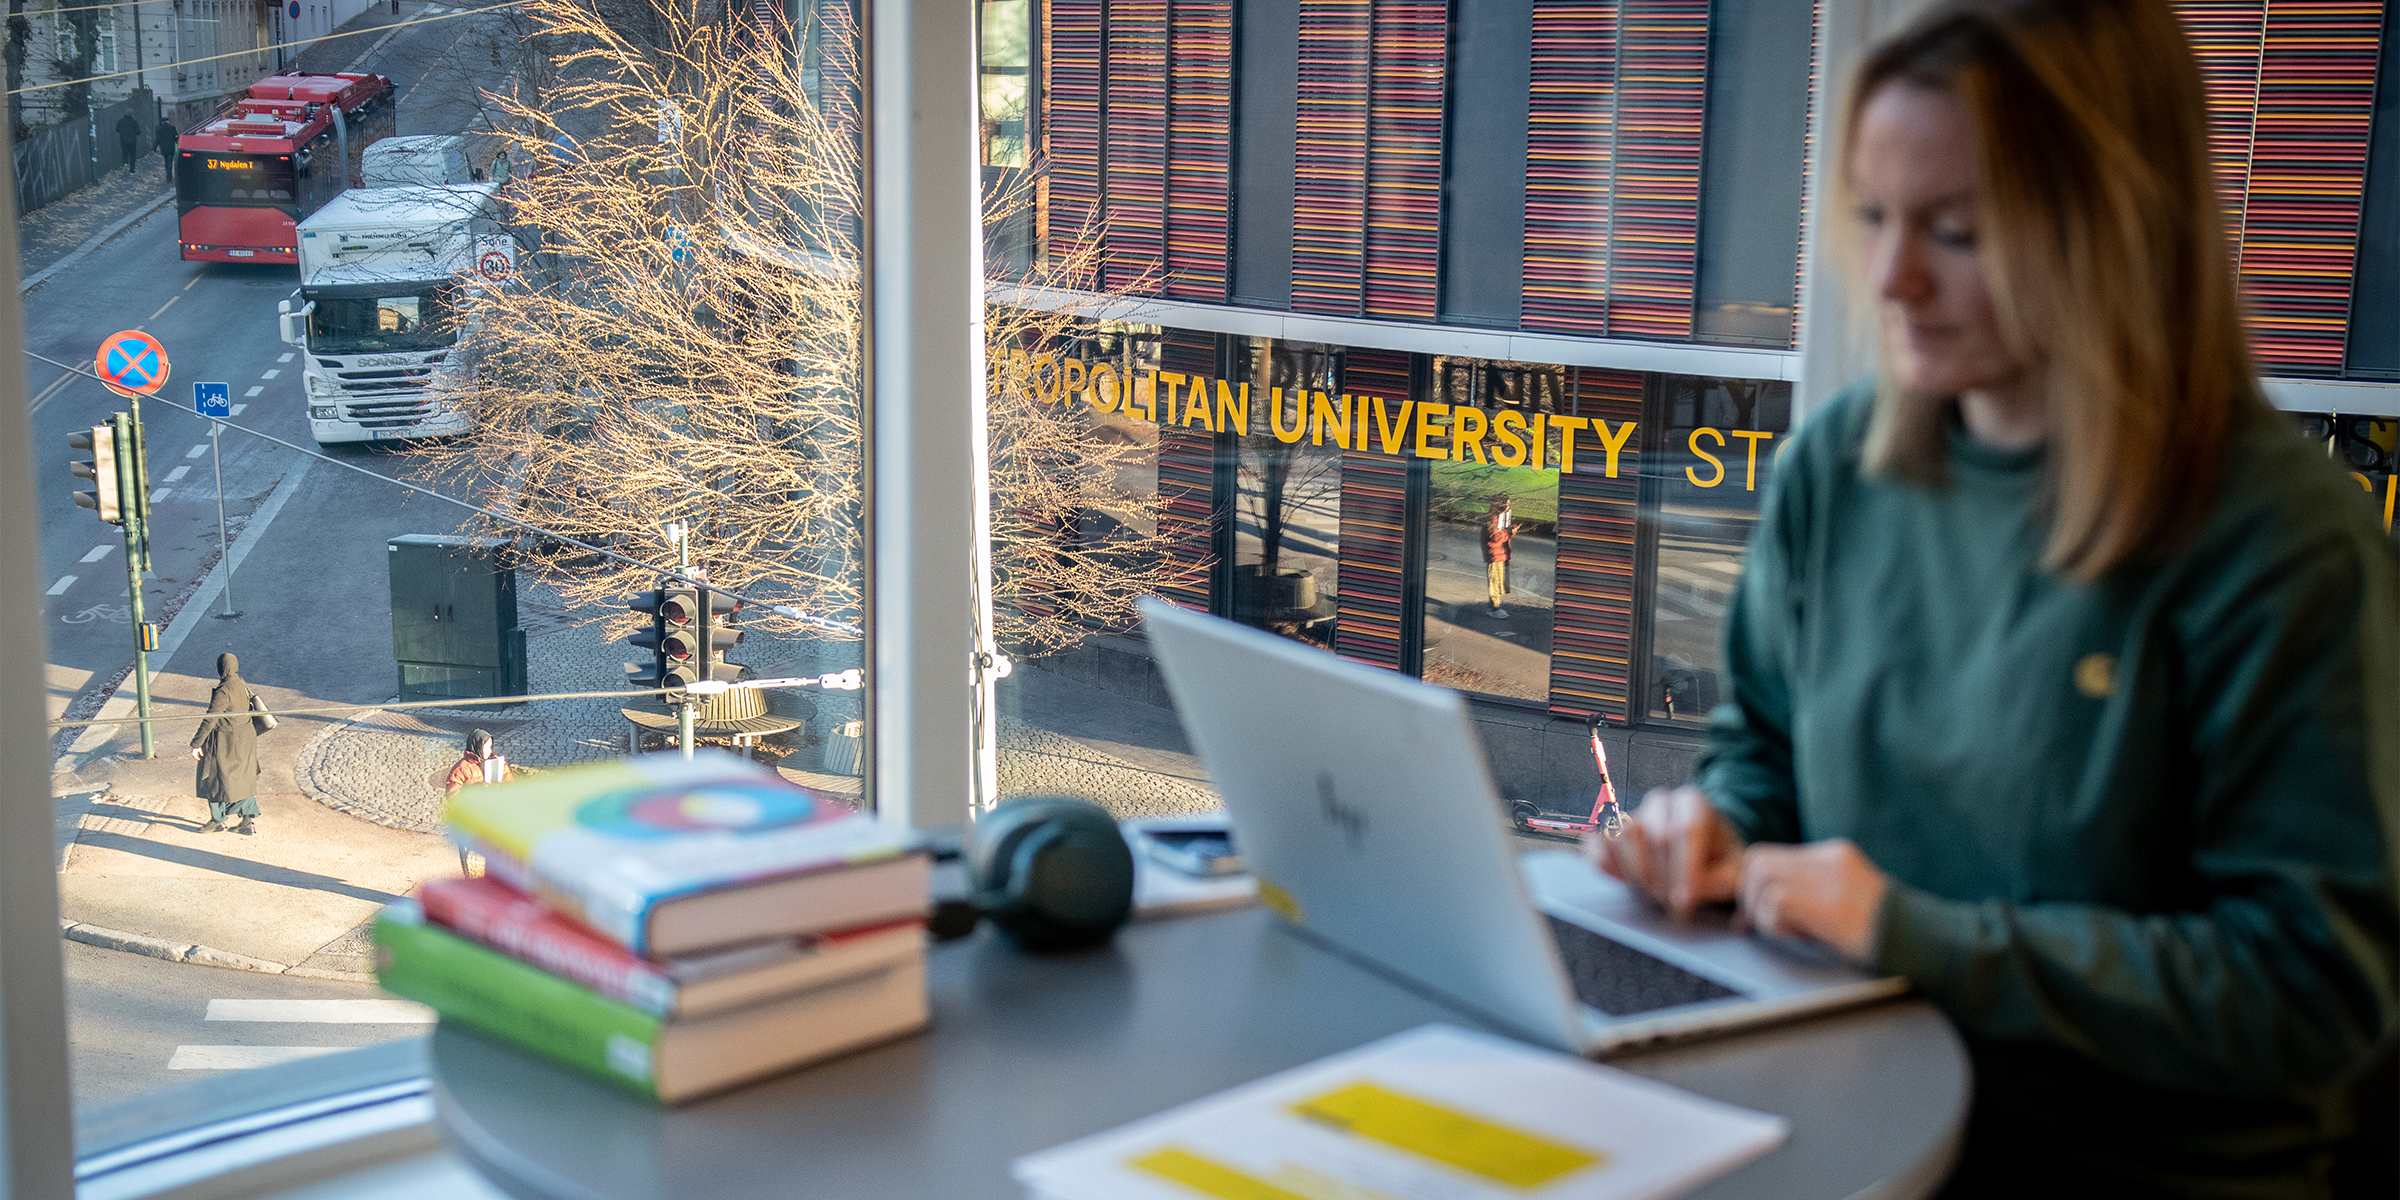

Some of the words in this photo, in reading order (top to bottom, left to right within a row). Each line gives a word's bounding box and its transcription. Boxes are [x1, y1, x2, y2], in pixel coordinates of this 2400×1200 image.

[207, 159, 218, 169] 37
[219, 160, 248, 170] Nydalen
[1271, 387, 1637, 479] UNIVERSITY
[1685, 427, 1796, 491] ST
